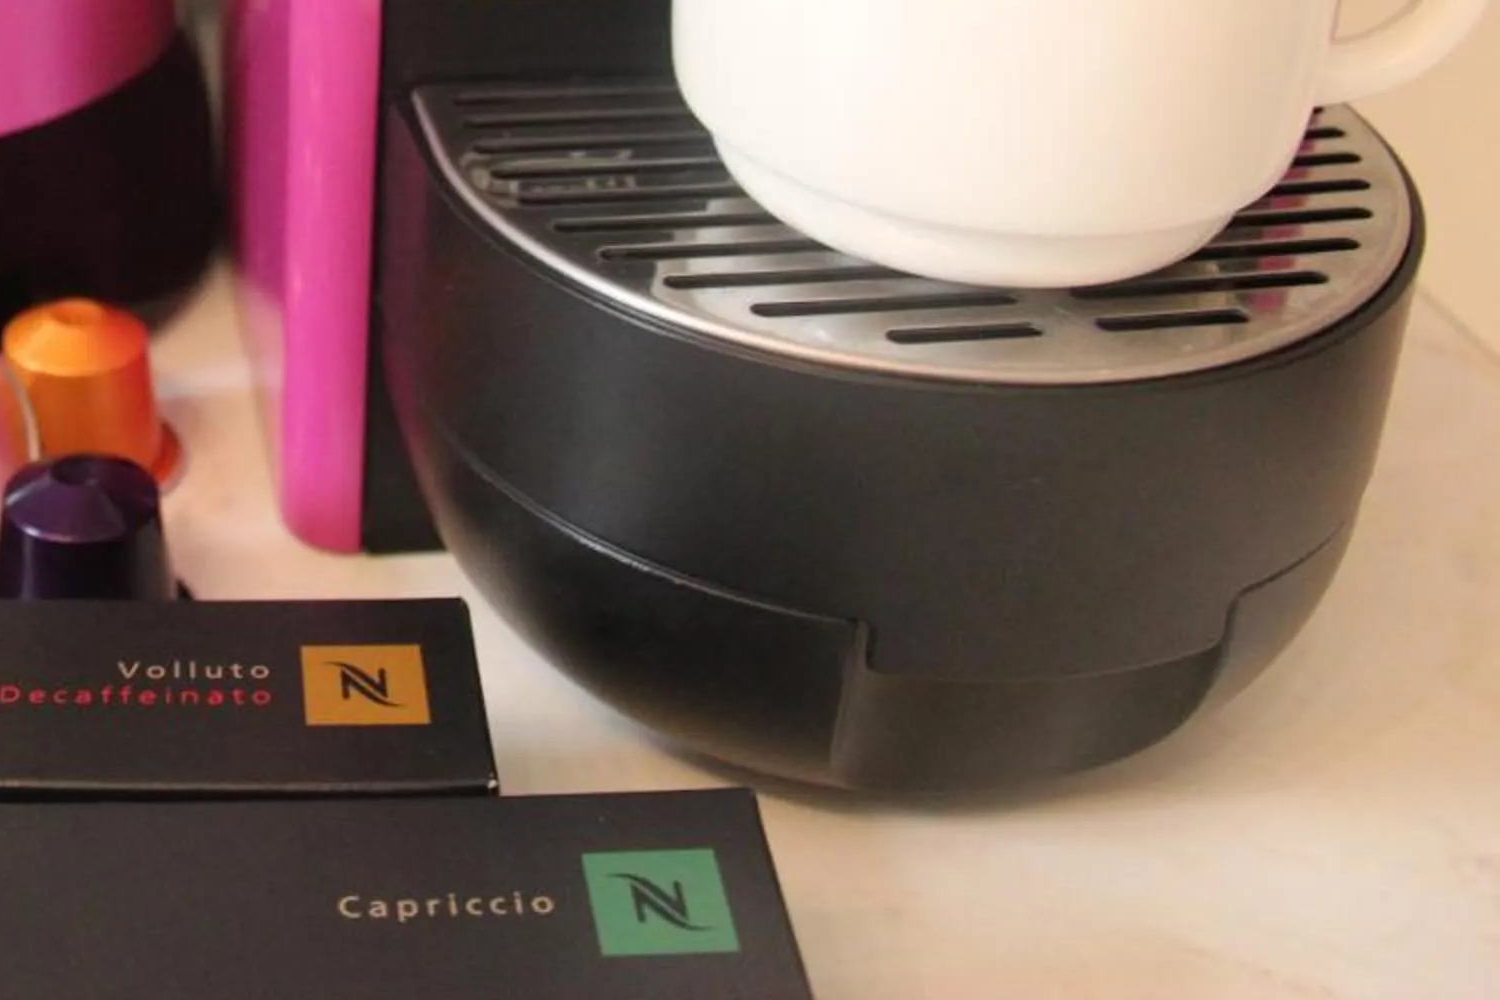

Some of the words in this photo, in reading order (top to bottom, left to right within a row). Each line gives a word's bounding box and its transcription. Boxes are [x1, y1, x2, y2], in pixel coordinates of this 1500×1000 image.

[117, 660, 270, 680] Volluto
[0, 684, 272, 706] Decaffeinato
[337, 890, 556, 924] Capriccio
